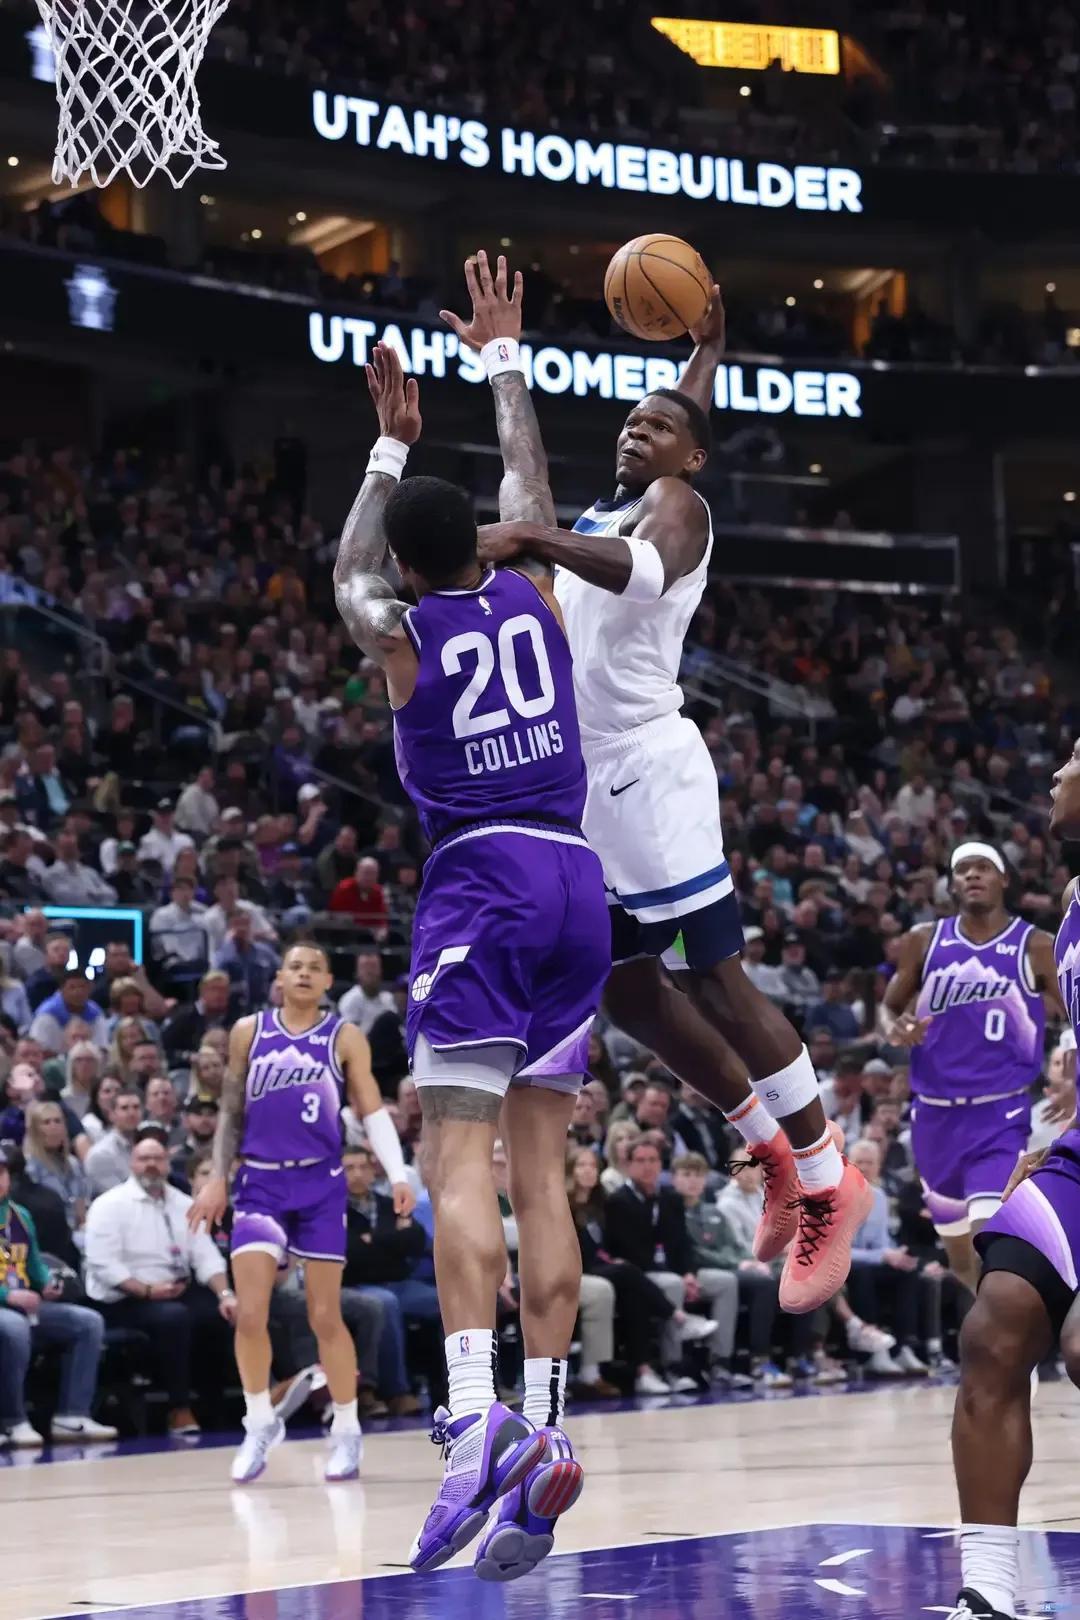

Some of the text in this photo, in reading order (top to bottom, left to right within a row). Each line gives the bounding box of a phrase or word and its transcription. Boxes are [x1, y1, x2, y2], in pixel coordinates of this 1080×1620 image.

[313, 90, 862, 212] UTAH'S HOMEBUILDER
[519, 345, 861, 418] OMEBILDER
[441, 614, 555, 739] 20
[464, 720, 564, 776] COLLINS
[929, 974, 1013, 1014] UTAH
[984, 1008, 1006, 1041] 0
[251, 1063, 326, 1101] UTAH
[301, 1092, 321, 1123] 3
